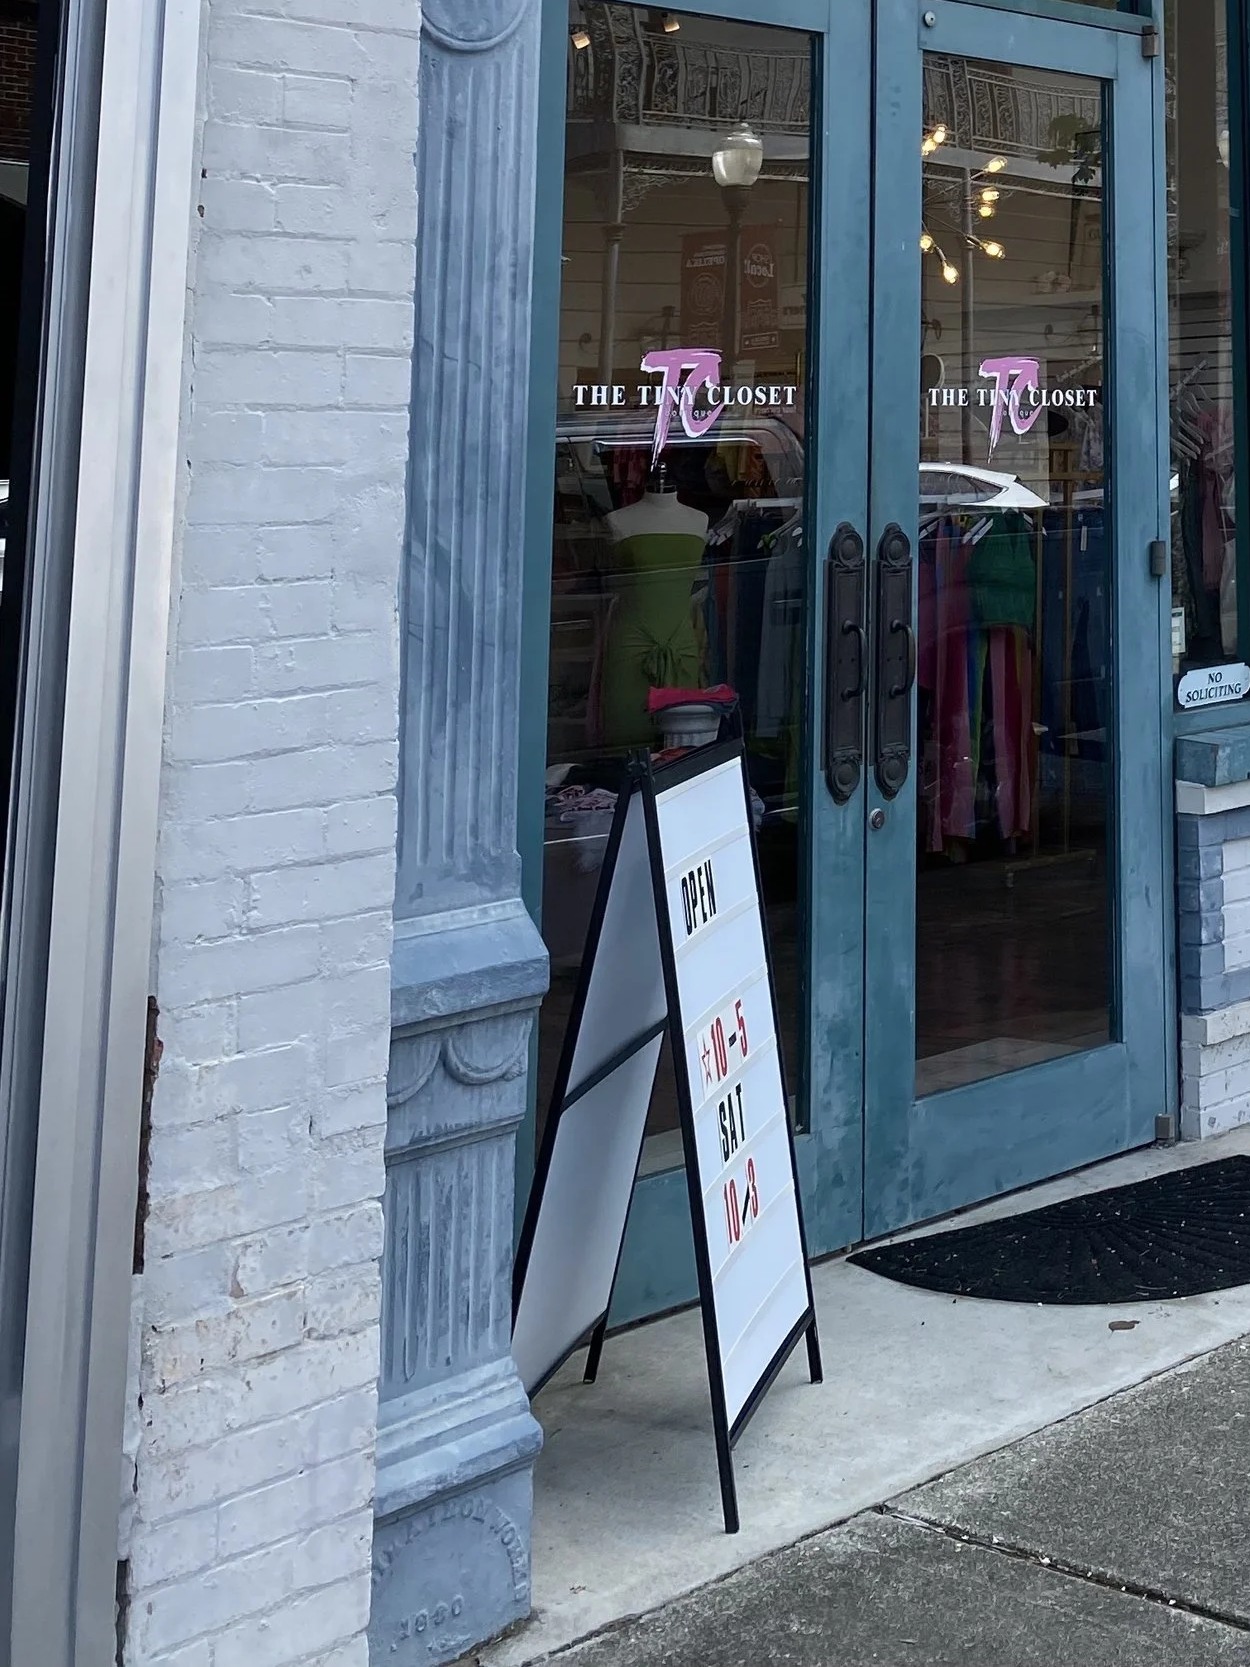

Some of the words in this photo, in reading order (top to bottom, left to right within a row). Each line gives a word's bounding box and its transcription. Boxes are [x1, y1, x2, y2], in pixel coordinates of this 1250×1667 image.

[573, 385, 626, 406] THE
[638, 385, 698, 406] TINY
[707, 385, 797, 406] CLOSET
[929, 388, 968, 407] THE
[977, 388, 1020, 407] TINY
[1029, 389, 1097, 407] CLOSET
[1207, 672, 1222, 685] NO
[1185, 683, 1242, 703] SOLICITING
[681, 859, 717, 936] OPEN
[718, 1082, 746, 1163] SAT
